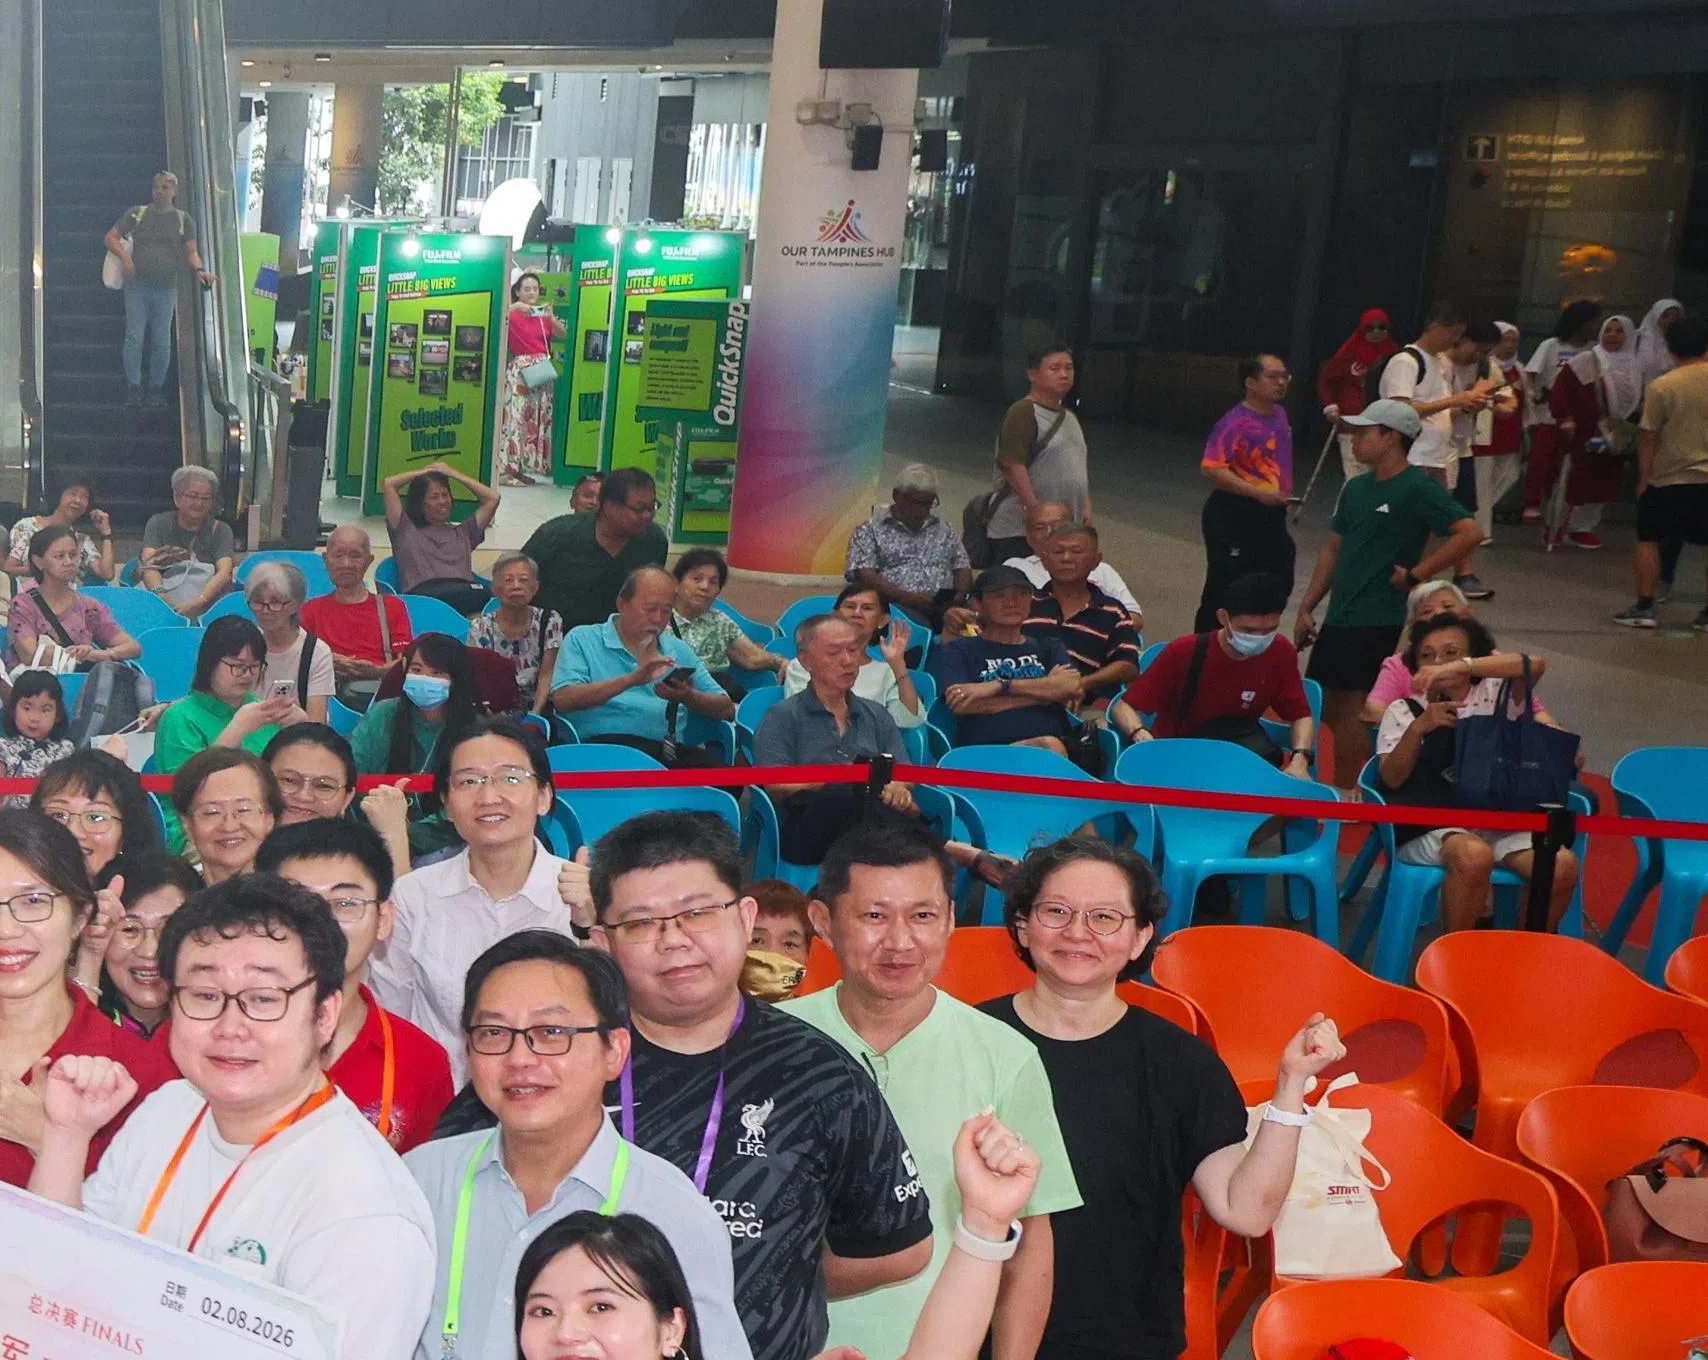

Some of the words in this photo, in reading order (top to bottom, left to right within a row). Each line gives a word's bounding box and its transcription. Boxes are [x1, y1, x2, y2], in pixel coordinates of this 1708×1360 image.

[781, 246, 807, 257] OUR
[810, 246, 875, 258] TAMPINES
[876, 247, 895, 257] HUB
[580, 268, 605, 280] LITTLE
[625, 276, 652, 289] LITTLE
[653, 275, 667, 287] BIG
[668, 273, 694, 286] VIEWS
[387, 279, 413, 294] LITTLE
[414, 278, 429, 292] BIG
[430, 277, 456, 290] VIEWS
[713, 301, 750, 426] QuickSnap
[400, 403, 464, 431] Selected
[411, 428, 457, 452] Works
[165, 1280, 188, 1299] 日期
[160, 1294, 185, 1313] Date
[28, 1293, 78, 1330] 总决赛
[83, 1316, 145, 1356] FINALS
[201, 1297, 295, 1348] 02.08.2026
